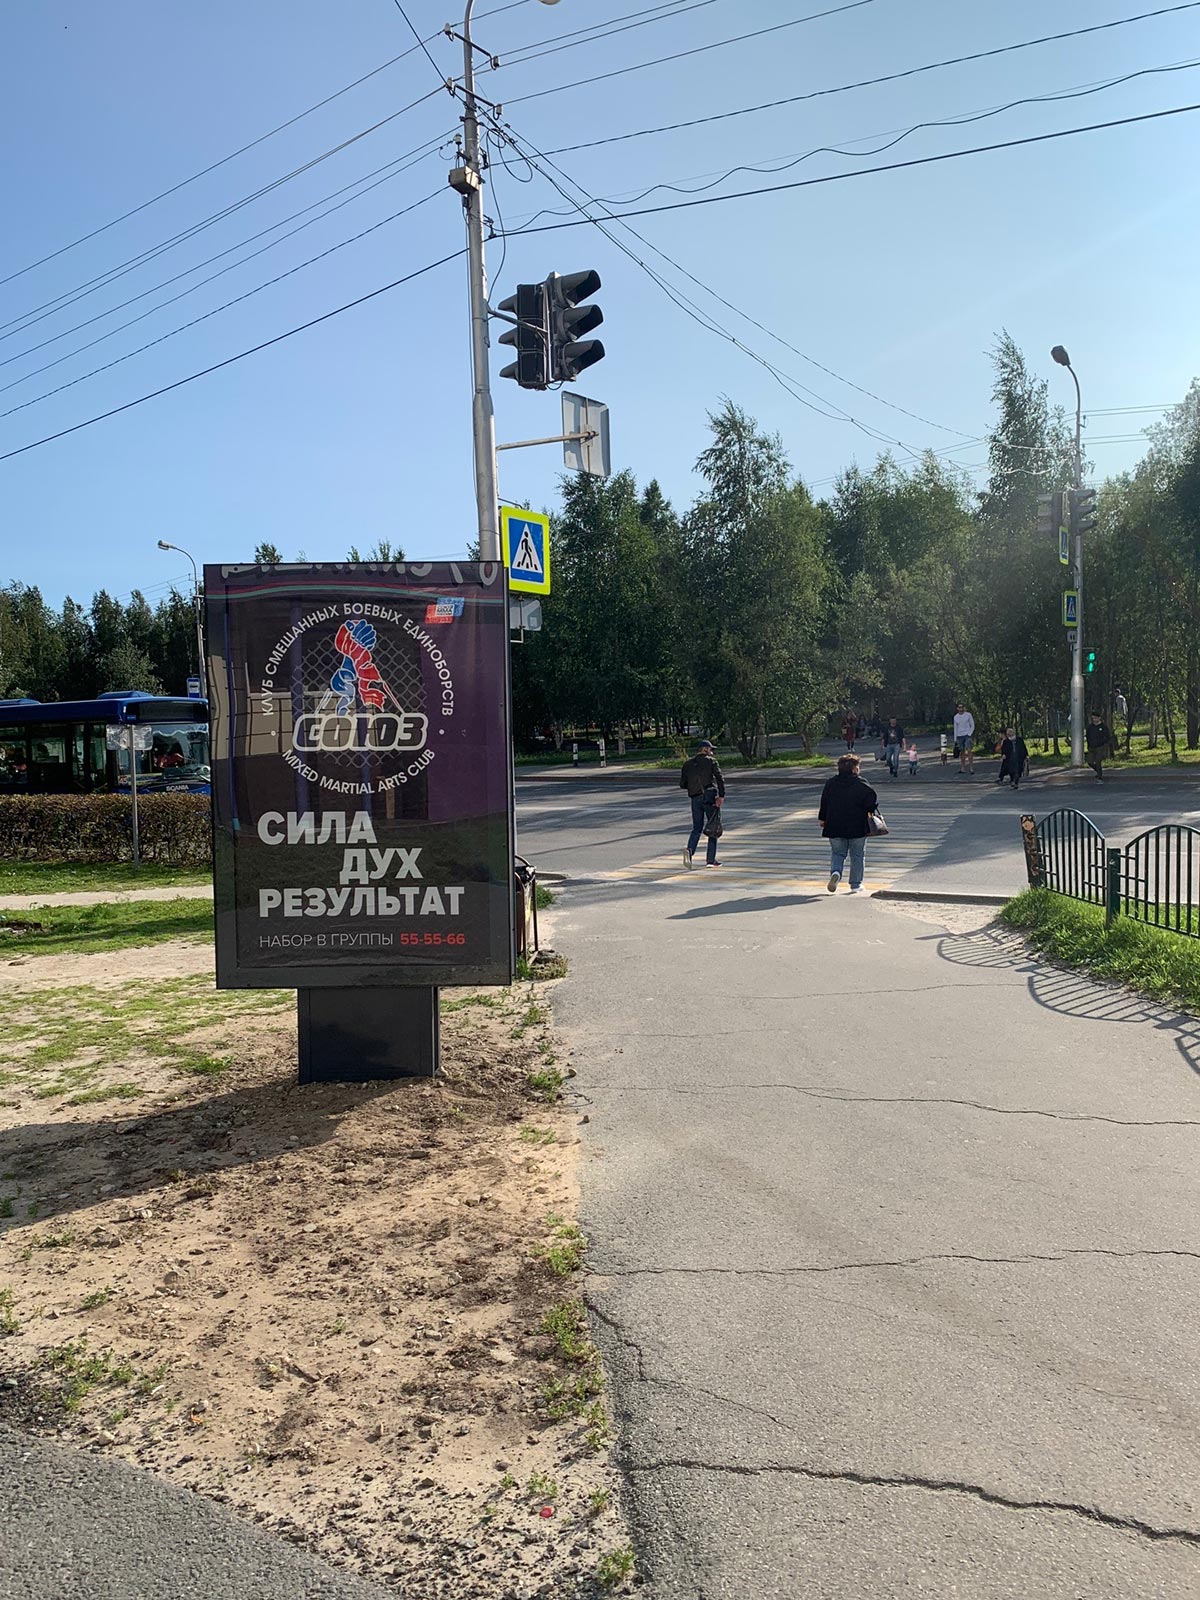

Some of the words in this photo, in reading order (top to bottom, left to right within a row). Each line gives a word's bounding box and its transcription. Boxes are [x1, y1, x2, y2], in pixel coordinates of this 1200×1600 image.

[343, 602, 403, 625] БОЕВЫХ
[265, 605, 339, 676] СМЕШАННЫХ
[402, 618, 454, 717] ЕДИНОБОРСТВ
[262, 679, 274, 716] КЛУБ
[292, 712, 429, 751] СОЮЗ
[282, 749, 319, 783] MIXED
[319, 775, 375, 795] MARTIAL
[377, 771, 408, 793] ARTS
[407, 748, 436, 777] CLUB
[257, 810, 378, 846] СИЛА
[339, 847, 424, 885] ДУХ
[258, 886, 465, 918] РЕЗУЛЬТАТ
[259, 935, 313, 948] НАБОР
[316, 934, 327, 946] В
[331, 933, 394, 946] ГРУППЫ
[400, 933, 466, 945] 55-55-66
